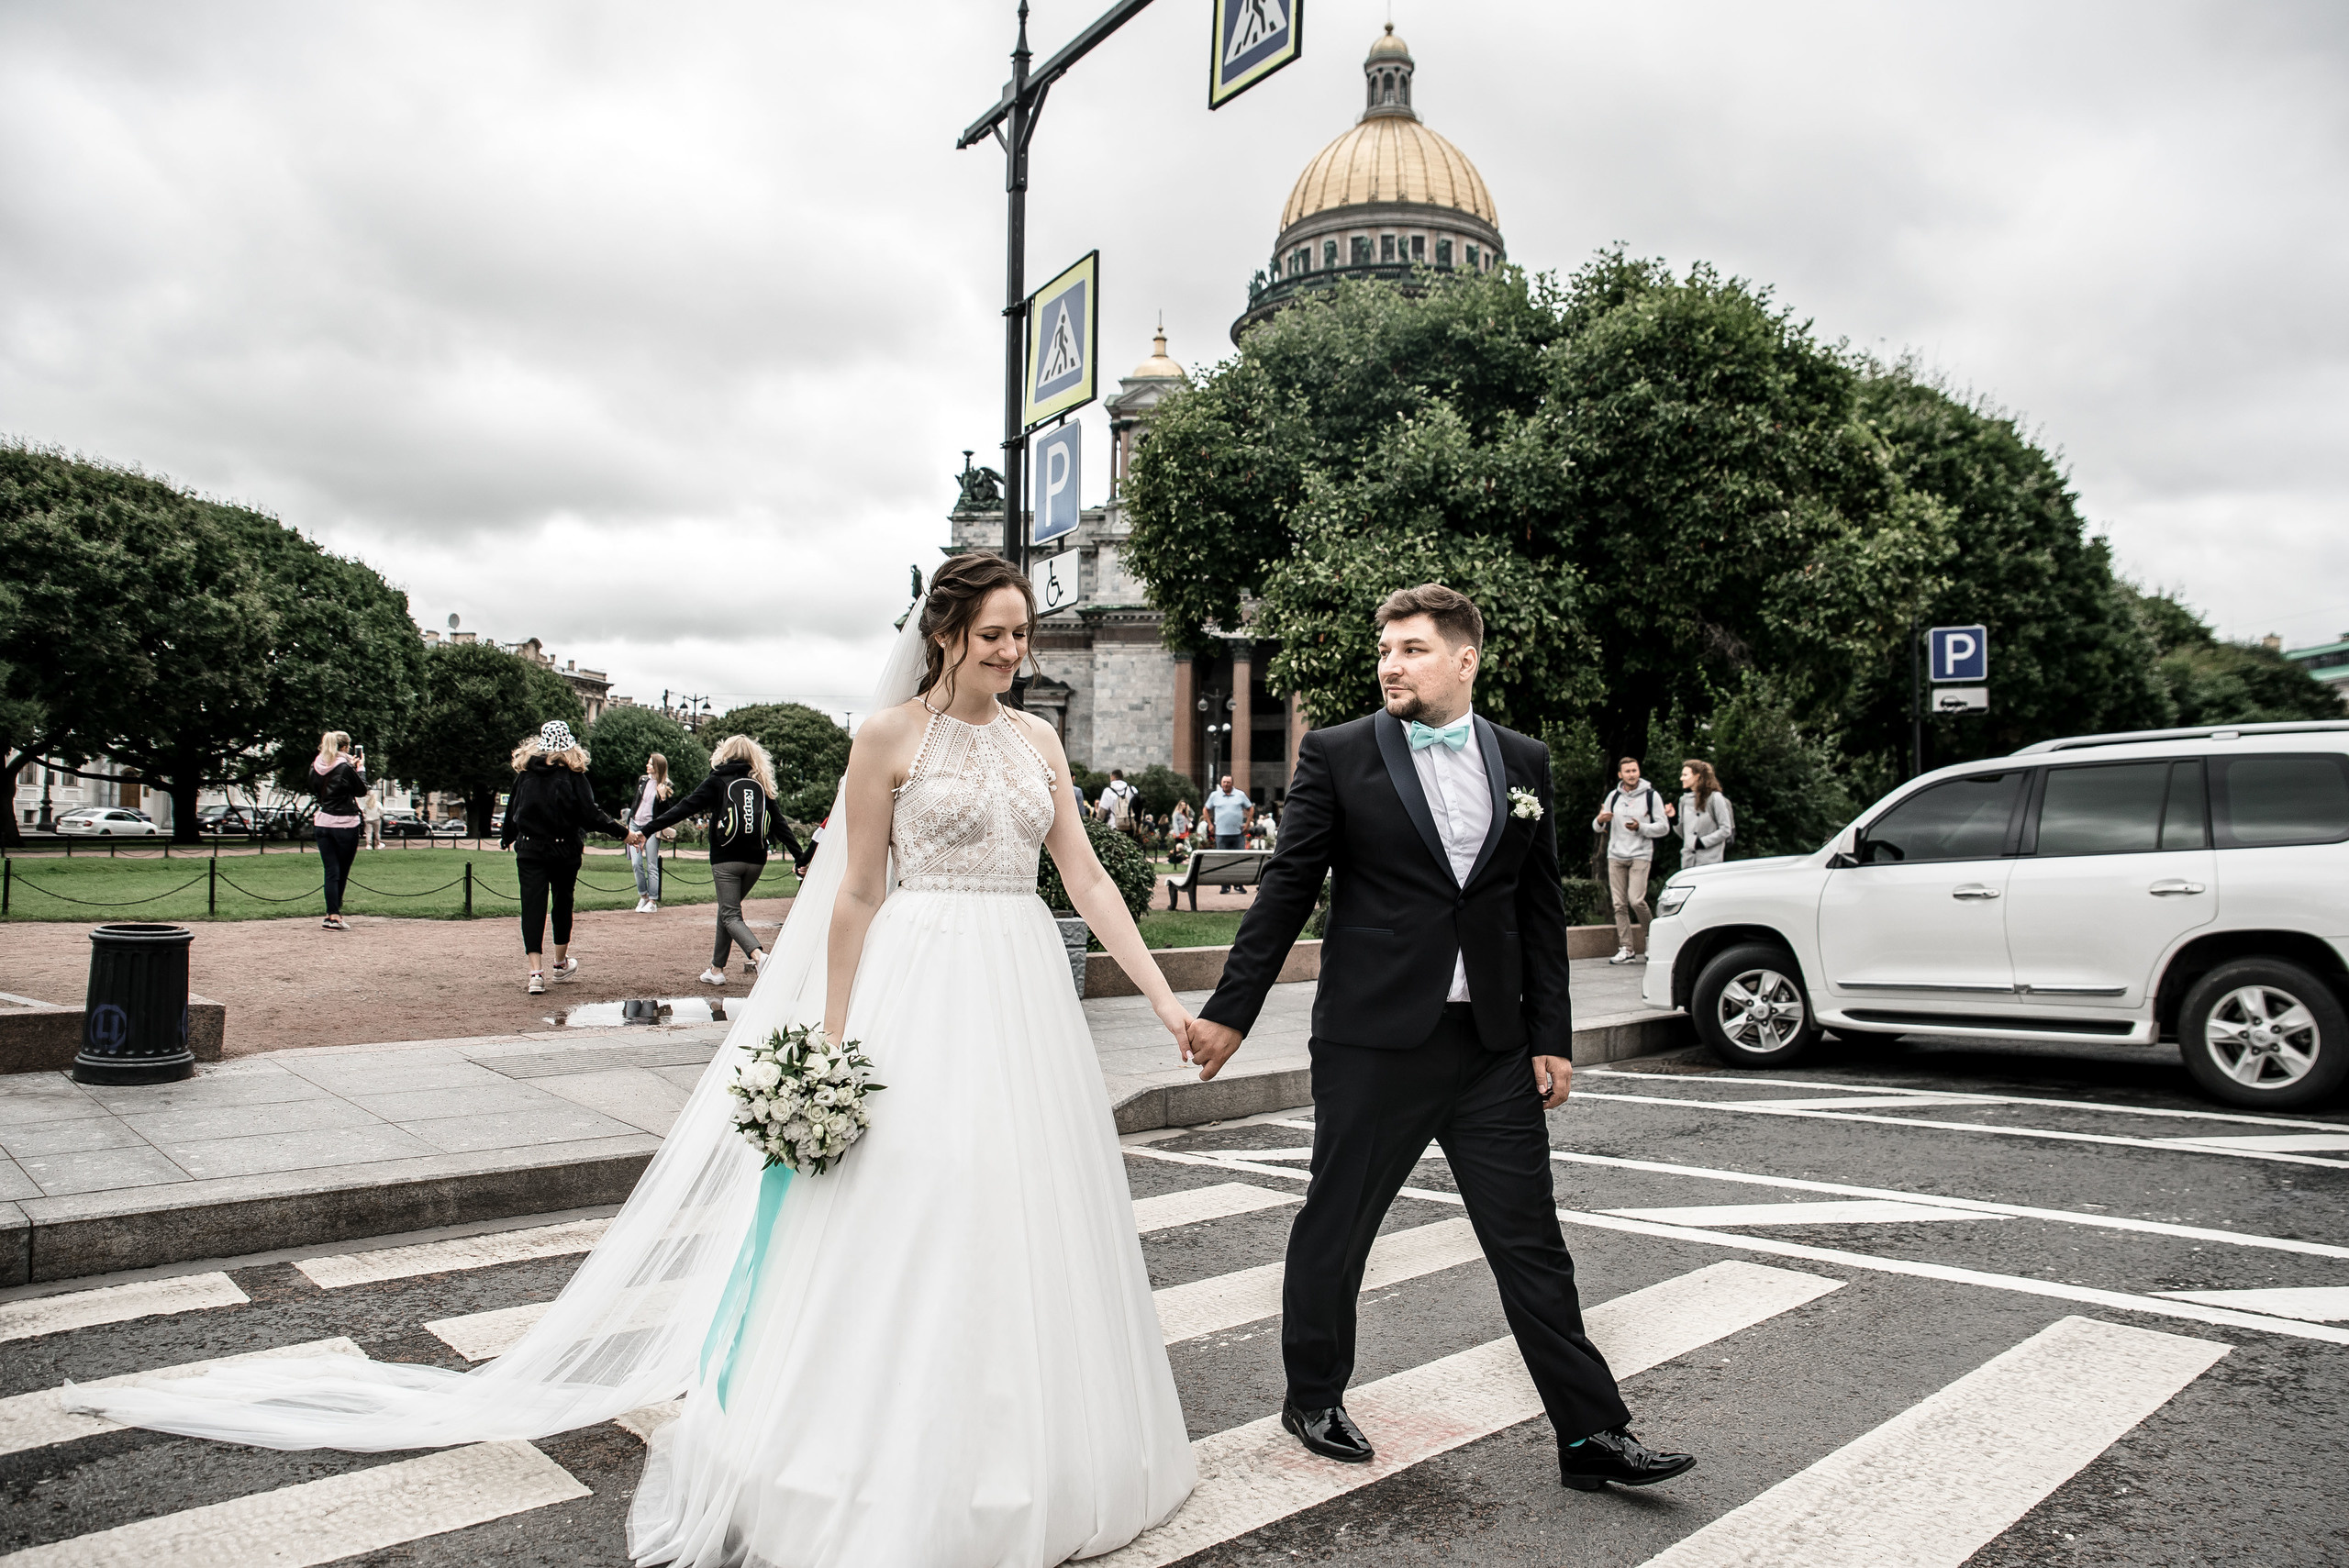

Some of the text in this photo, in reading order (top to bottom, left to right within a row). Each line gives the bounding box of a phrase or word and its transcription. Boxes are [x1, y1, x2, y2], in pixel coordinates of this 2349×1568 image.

[1045, 440, 1070, 528] P
[1945, 633, 1976, 675] P
[743, 788, 754, 834] Kappa
